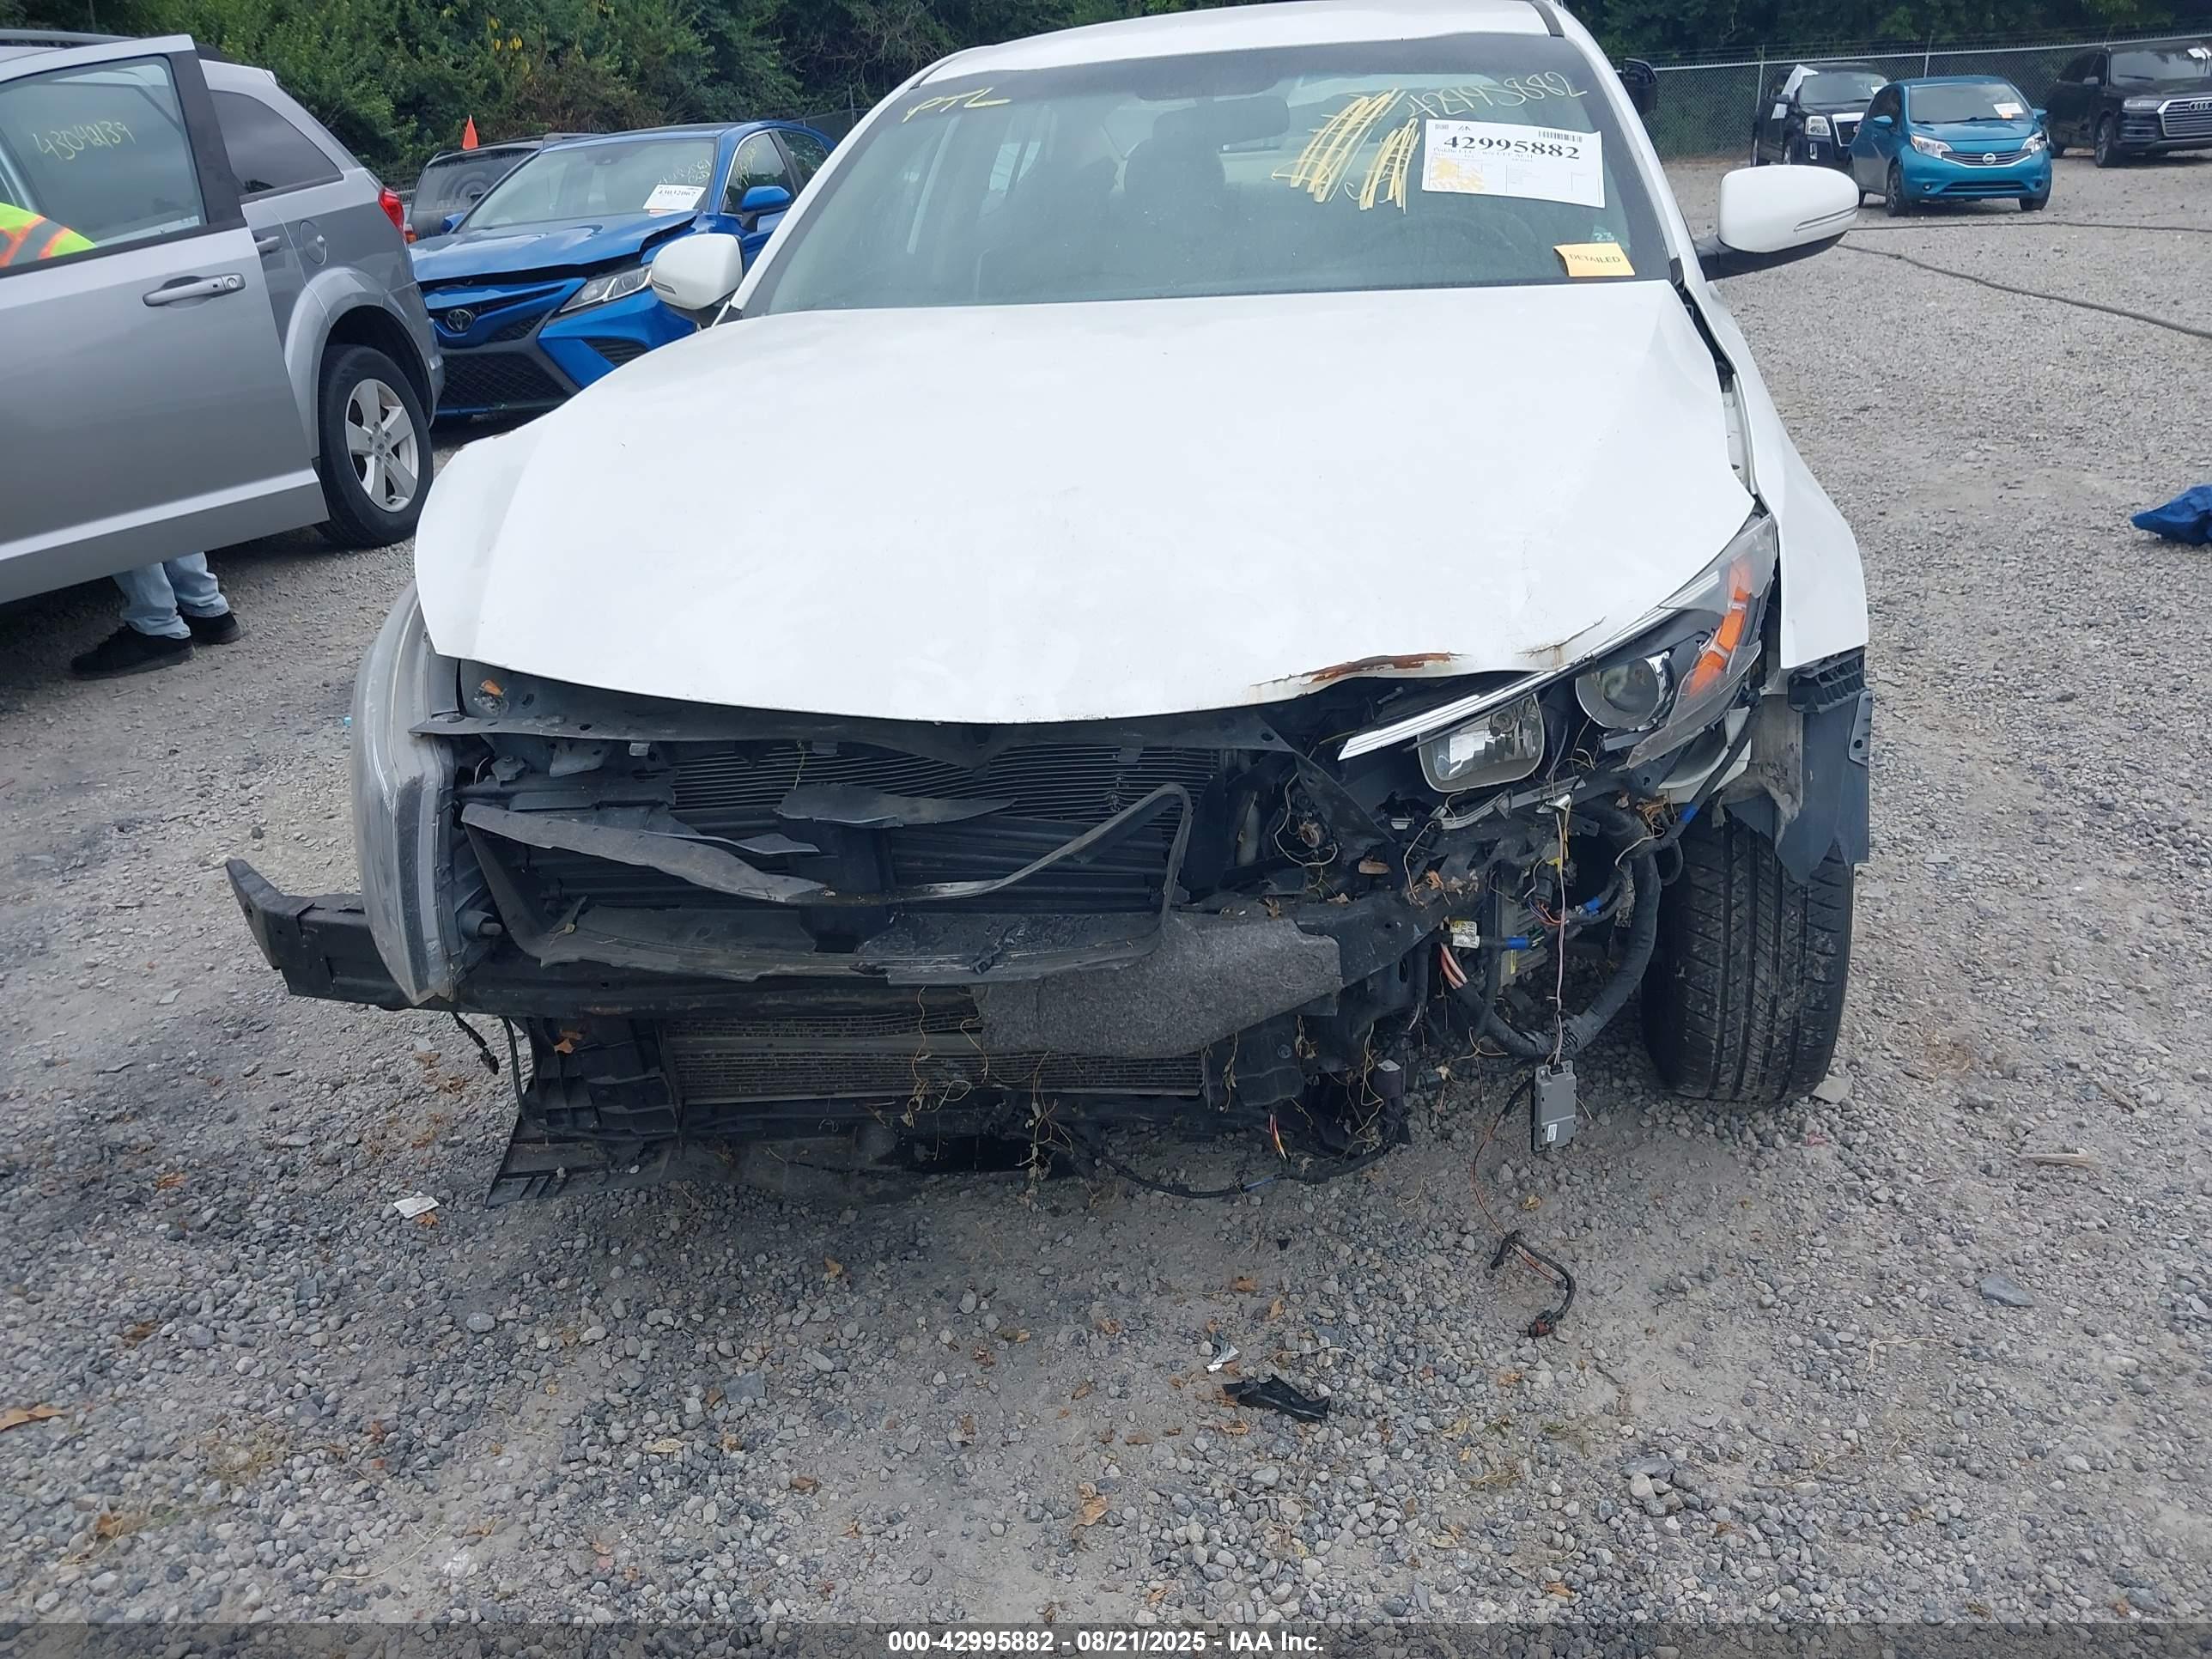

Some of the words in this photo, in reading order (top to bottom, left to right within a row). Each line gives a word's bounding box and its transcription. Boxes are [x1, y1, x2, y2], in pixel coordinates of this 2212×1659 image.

[1408, 71, 1588, 118] 42995882
[1443, 136, 1580, 160] 42995882
[1568, 252, 1621, 264] DETAILED
